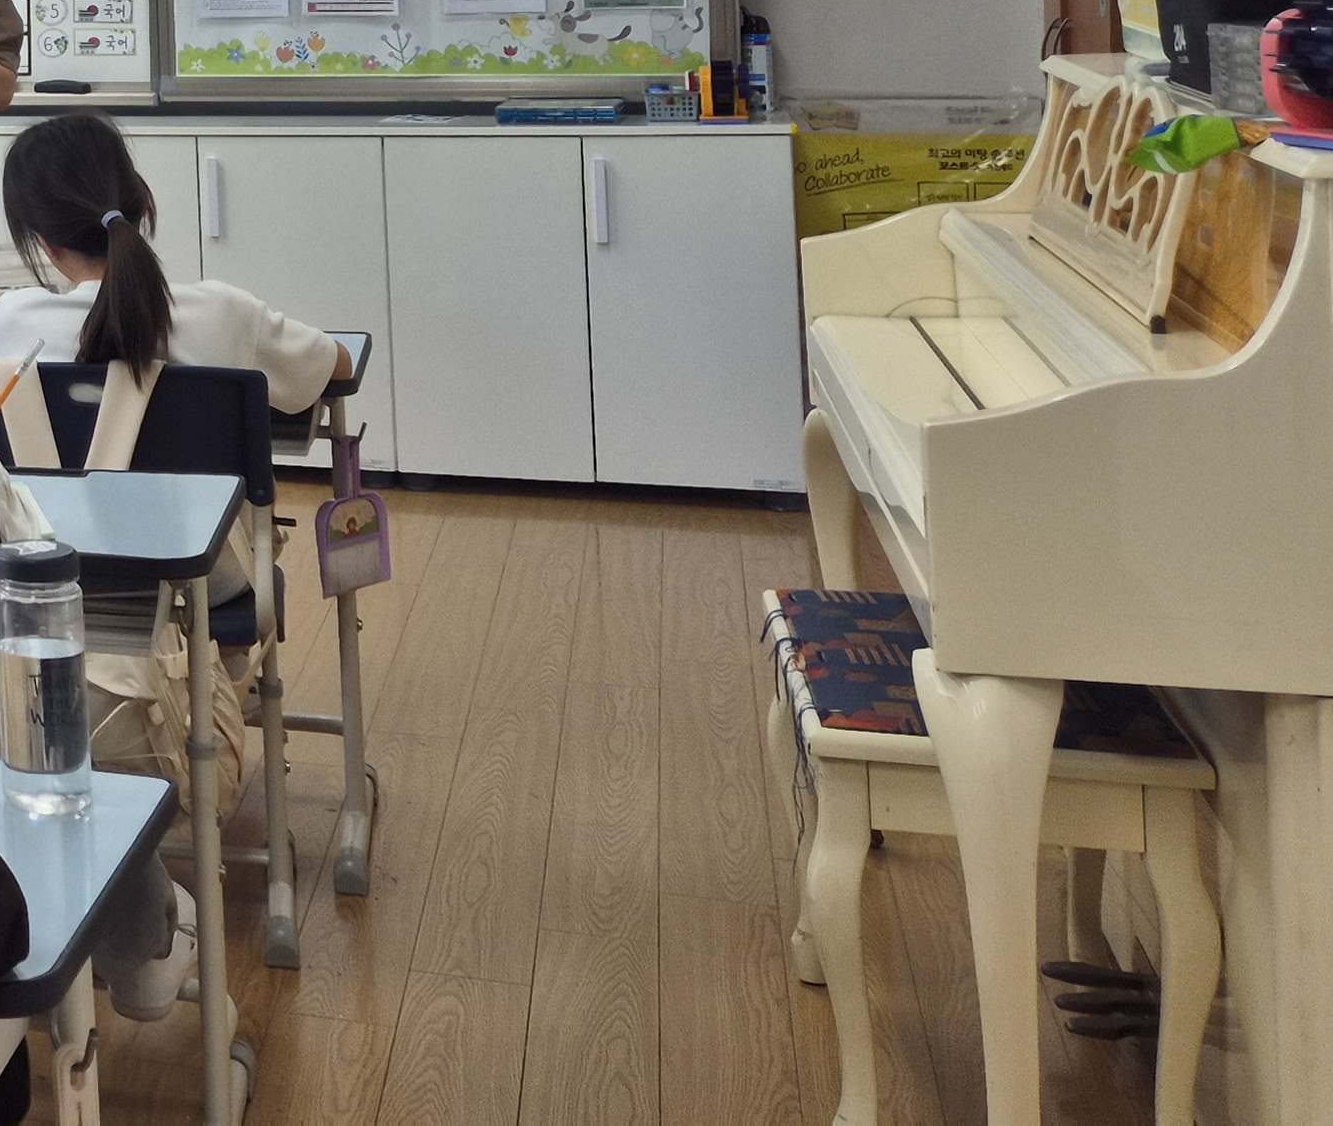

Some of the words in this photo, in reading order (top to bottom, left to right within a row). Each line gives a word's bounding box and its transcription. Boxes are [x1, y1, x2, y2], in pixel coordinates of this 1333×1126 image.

[50, 3, 59, 19] 5
[103, 3, 126, 18] 국어
[43, 36, 52, 52] 6
[105, 35, 128, 50] 국어
[815, 148, 864, 170] ahead,
[928, 147, 961, 159] 최고의
[965, 148, 987, 160] 미팅
[804, 165, 892, 192] Collaborate
